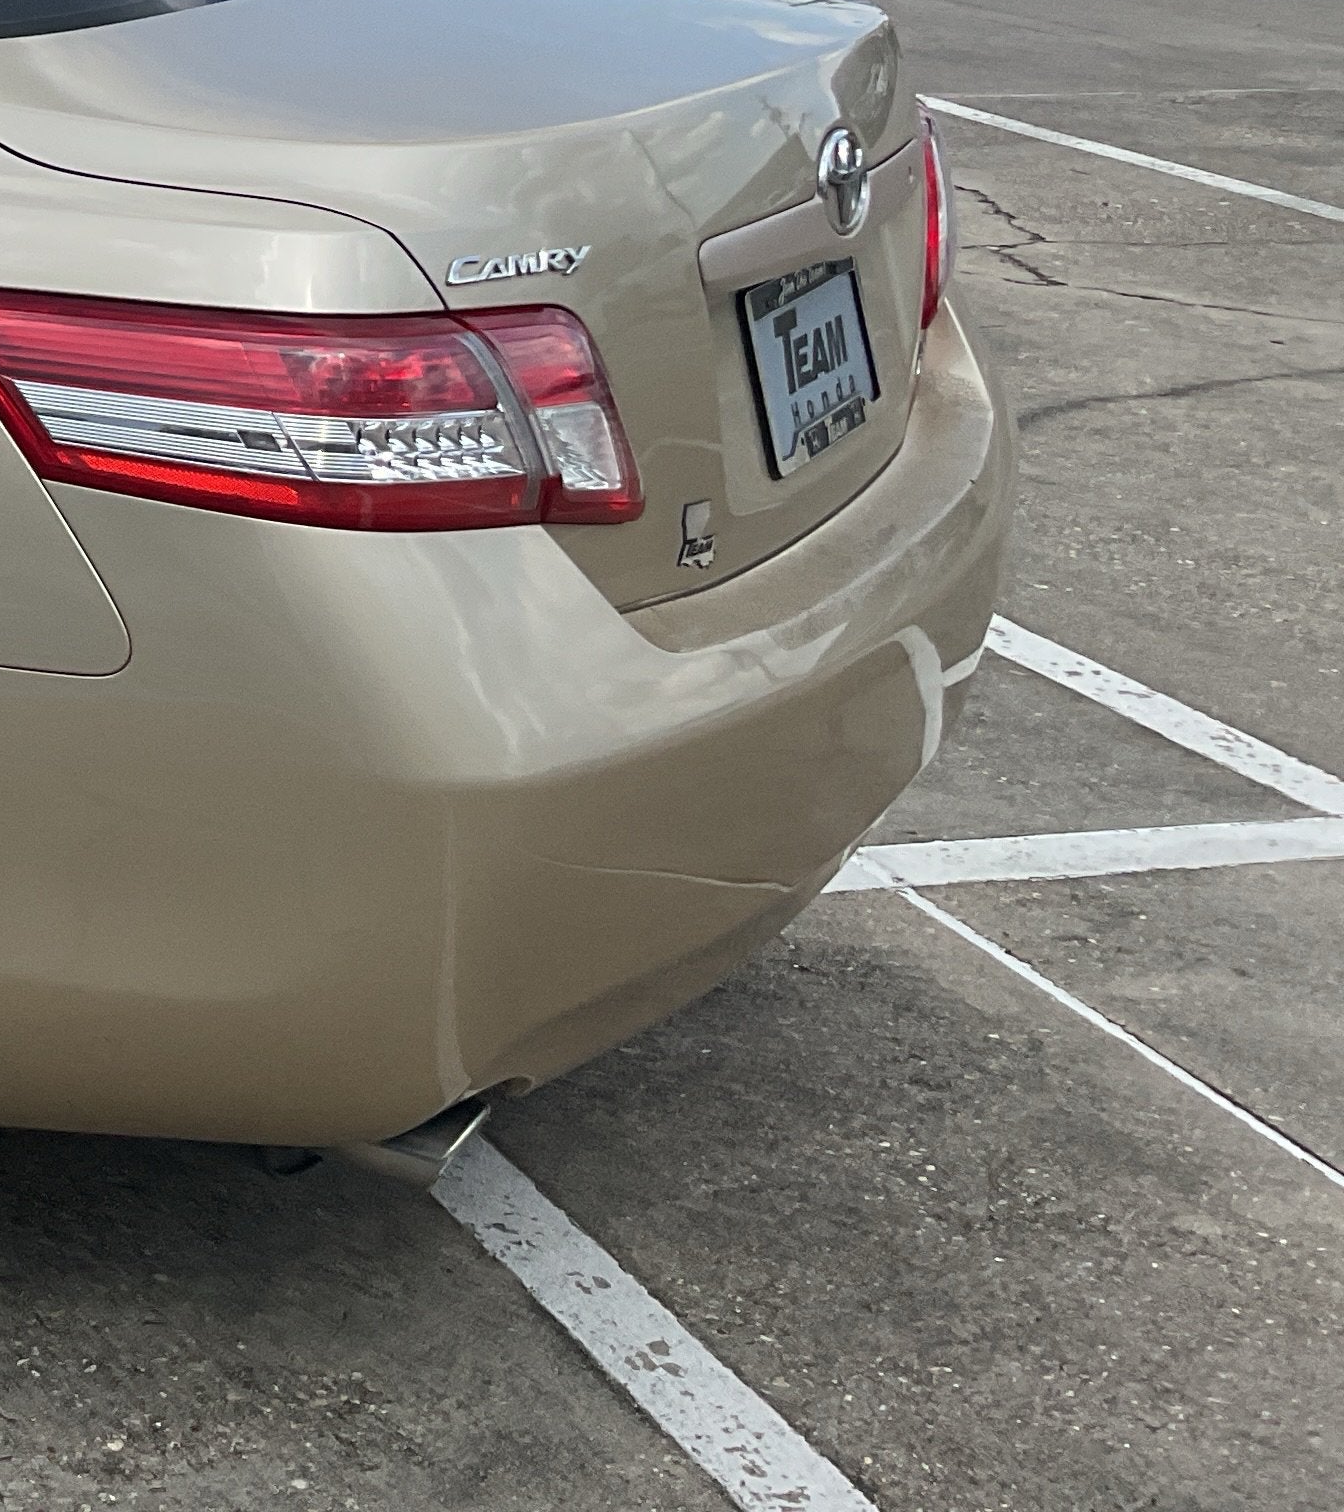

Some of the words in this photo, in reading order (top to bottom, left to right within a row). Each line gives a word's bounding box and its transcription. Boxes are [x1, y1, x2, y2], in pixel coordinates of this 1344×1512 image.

[446, 245, 592, 286] CAMRY
[773, 307, 848, 395] TEAM
[791, 374, 856, 427] Honda
